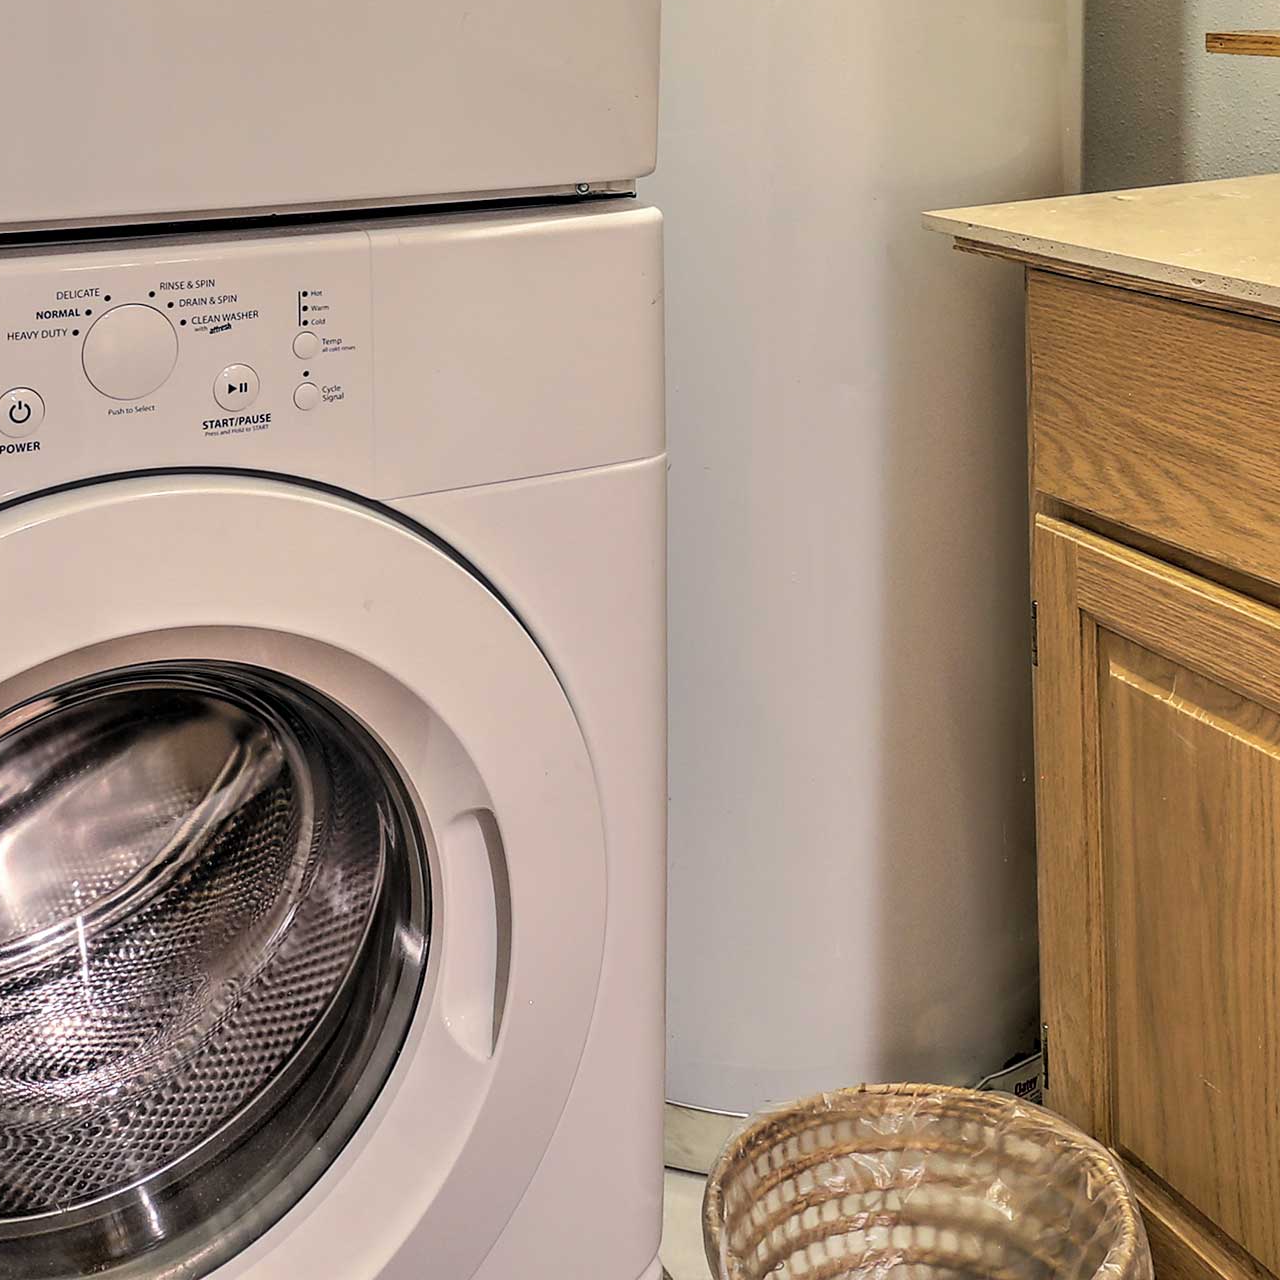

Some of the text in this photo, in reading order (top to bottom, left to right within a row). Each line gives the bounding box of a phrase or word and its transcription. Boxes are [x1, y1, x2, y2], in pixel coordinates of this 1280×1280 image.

[159, 279, 216, 291] RINSE & SPIN
[55, 288, 101, 301] DELICATE
[178, 294, 238, 308] DRAIN & SPIN
[36, 308, 81, 321] NORMAL
[191, 310, 259, 325] CLEAN WASHER
[310, 318, 326, 326] Cold
[7, 328, 68, 342] HEAVY DUTY
[322, 385, 342, 394] Cycle
[322, 392, 345, 402] Signal
[107, 404, 155, 416] Push to Select
[202, 413, 271, 430] START/PAUSE
[0, 441, 41, 455] POWER
